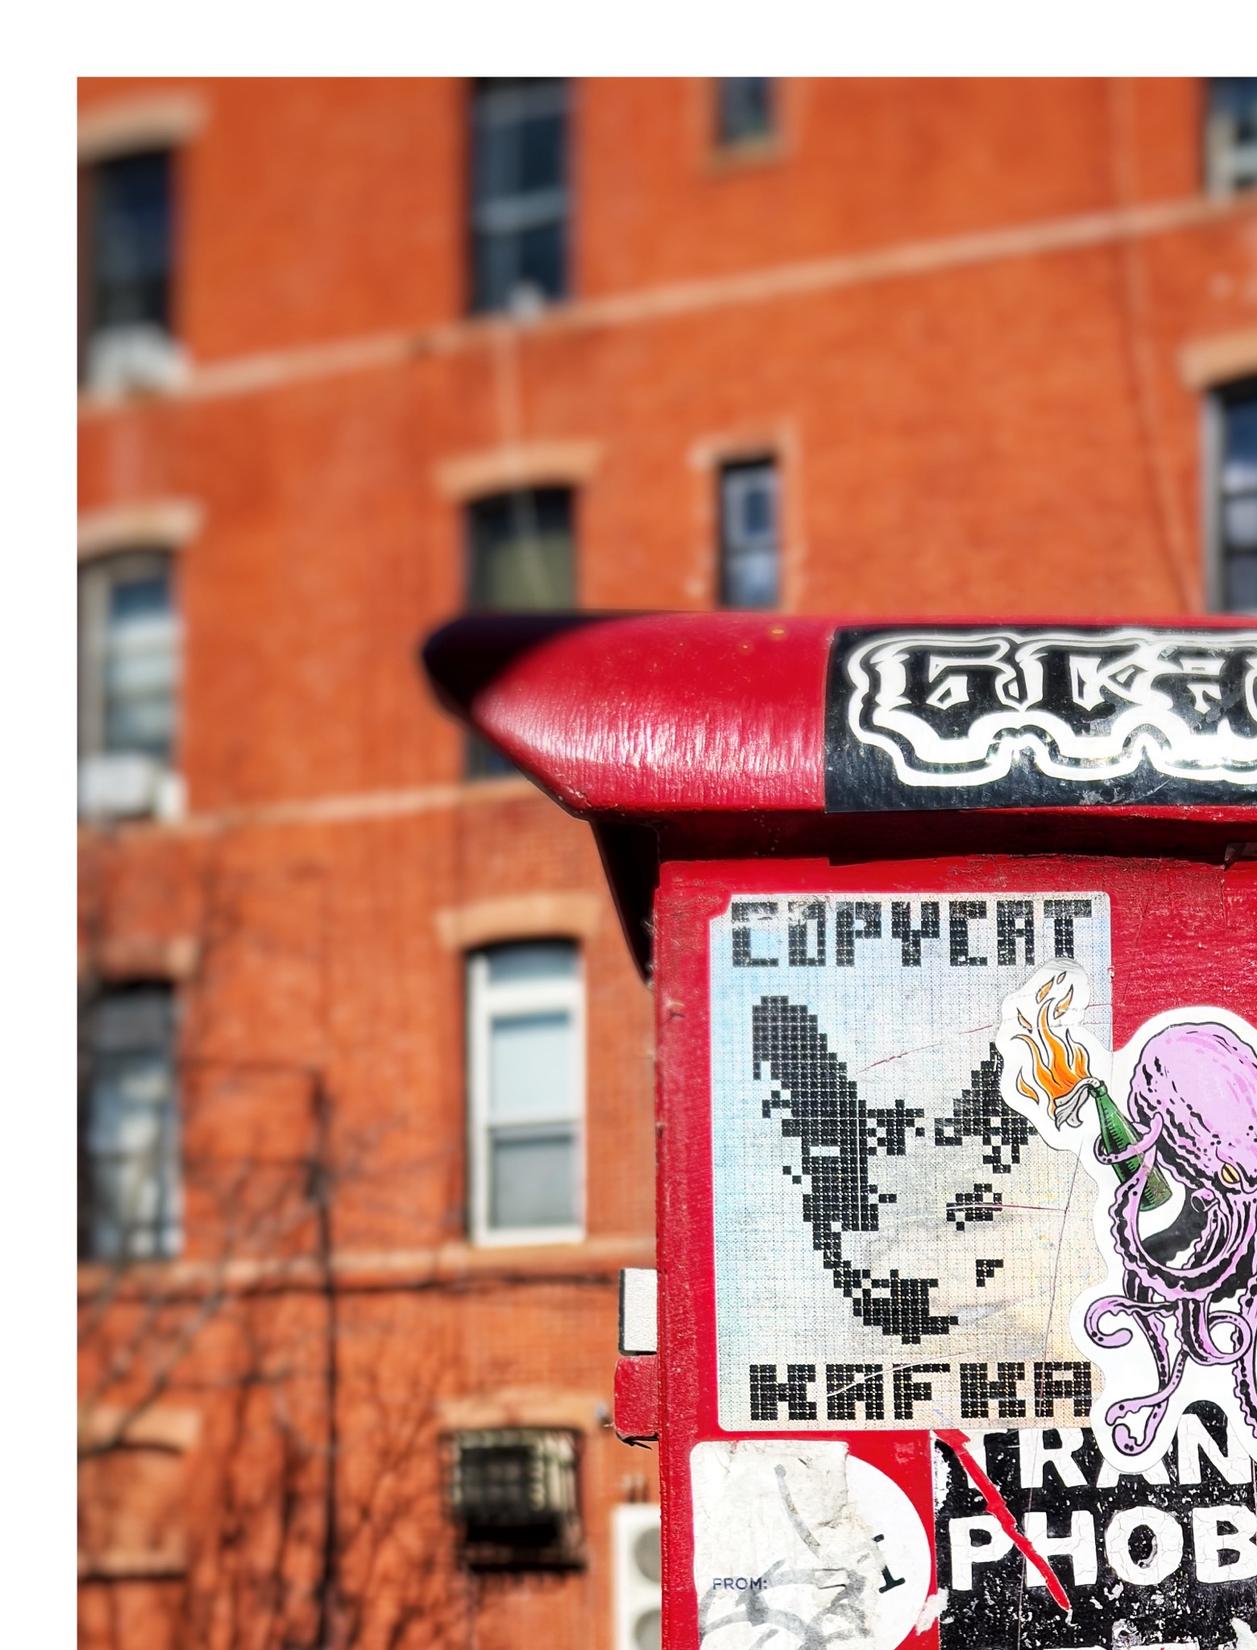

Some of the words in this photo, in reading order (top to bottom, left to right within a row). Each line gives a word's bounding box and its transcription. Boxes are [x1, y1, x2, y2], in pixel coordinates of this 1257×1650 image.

[731, 901, 1092, 967] COPYCAT
[749, 1361, 1092, 1421] KAFKA
[712, 1576, 768, 1591] FROM:
